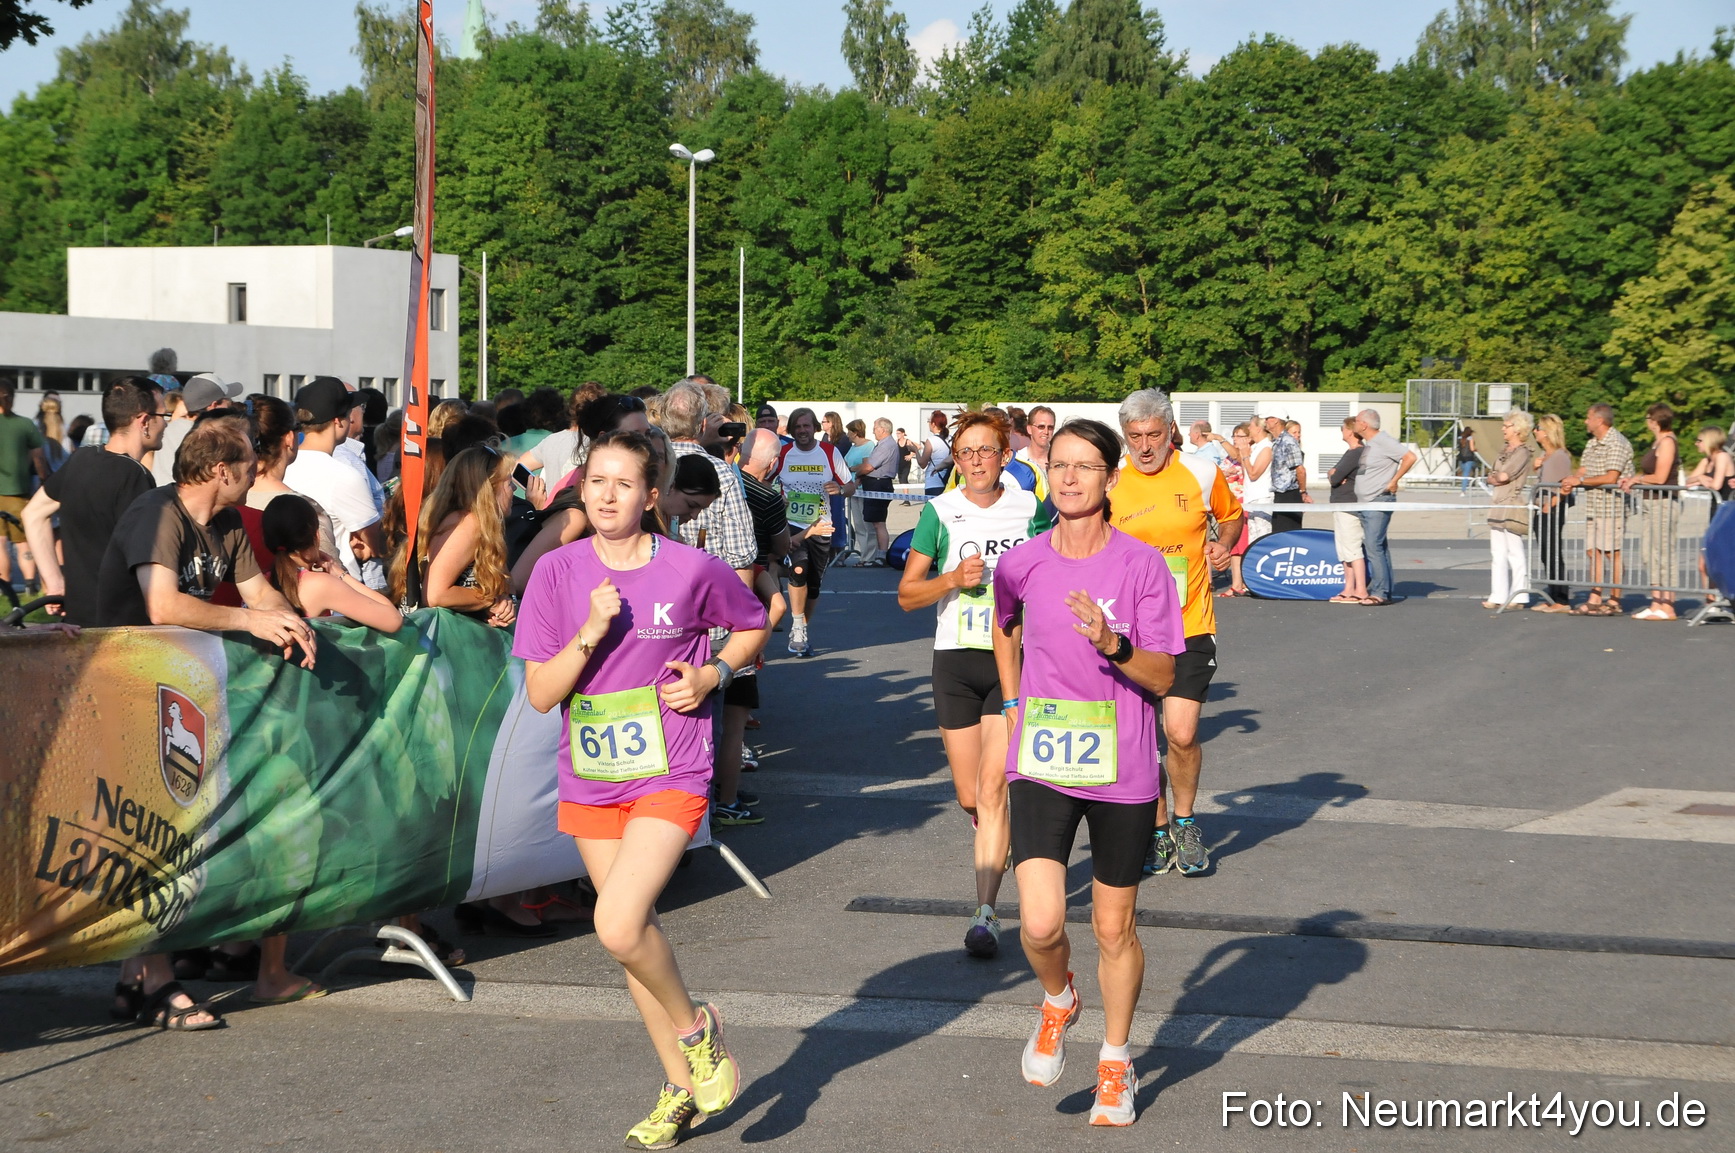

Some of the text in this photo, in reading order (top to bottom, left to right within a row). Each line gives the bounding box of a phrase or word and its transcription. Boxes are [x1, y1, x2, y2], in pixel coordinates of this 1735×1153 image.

[791, 502, 815, 516] 915
[1274, 560, 1345, 577] Fische
[1281, 577, 1346, 585] AUTOMOBIL
[653, 602, 675, 626] K
[1097, 598, 1117, 621] K
[637, 627, 684, 635] KÜFNER
[580, 721, 647, 759] 613
[1032, 729, 1101, 764] 612
[616, 759, 635, 767] Schulz
[620, 765, 638, 773] Tiefbau
[639, 763, 656, 771] GmbH
[170, 771, 192, 797] 1628
